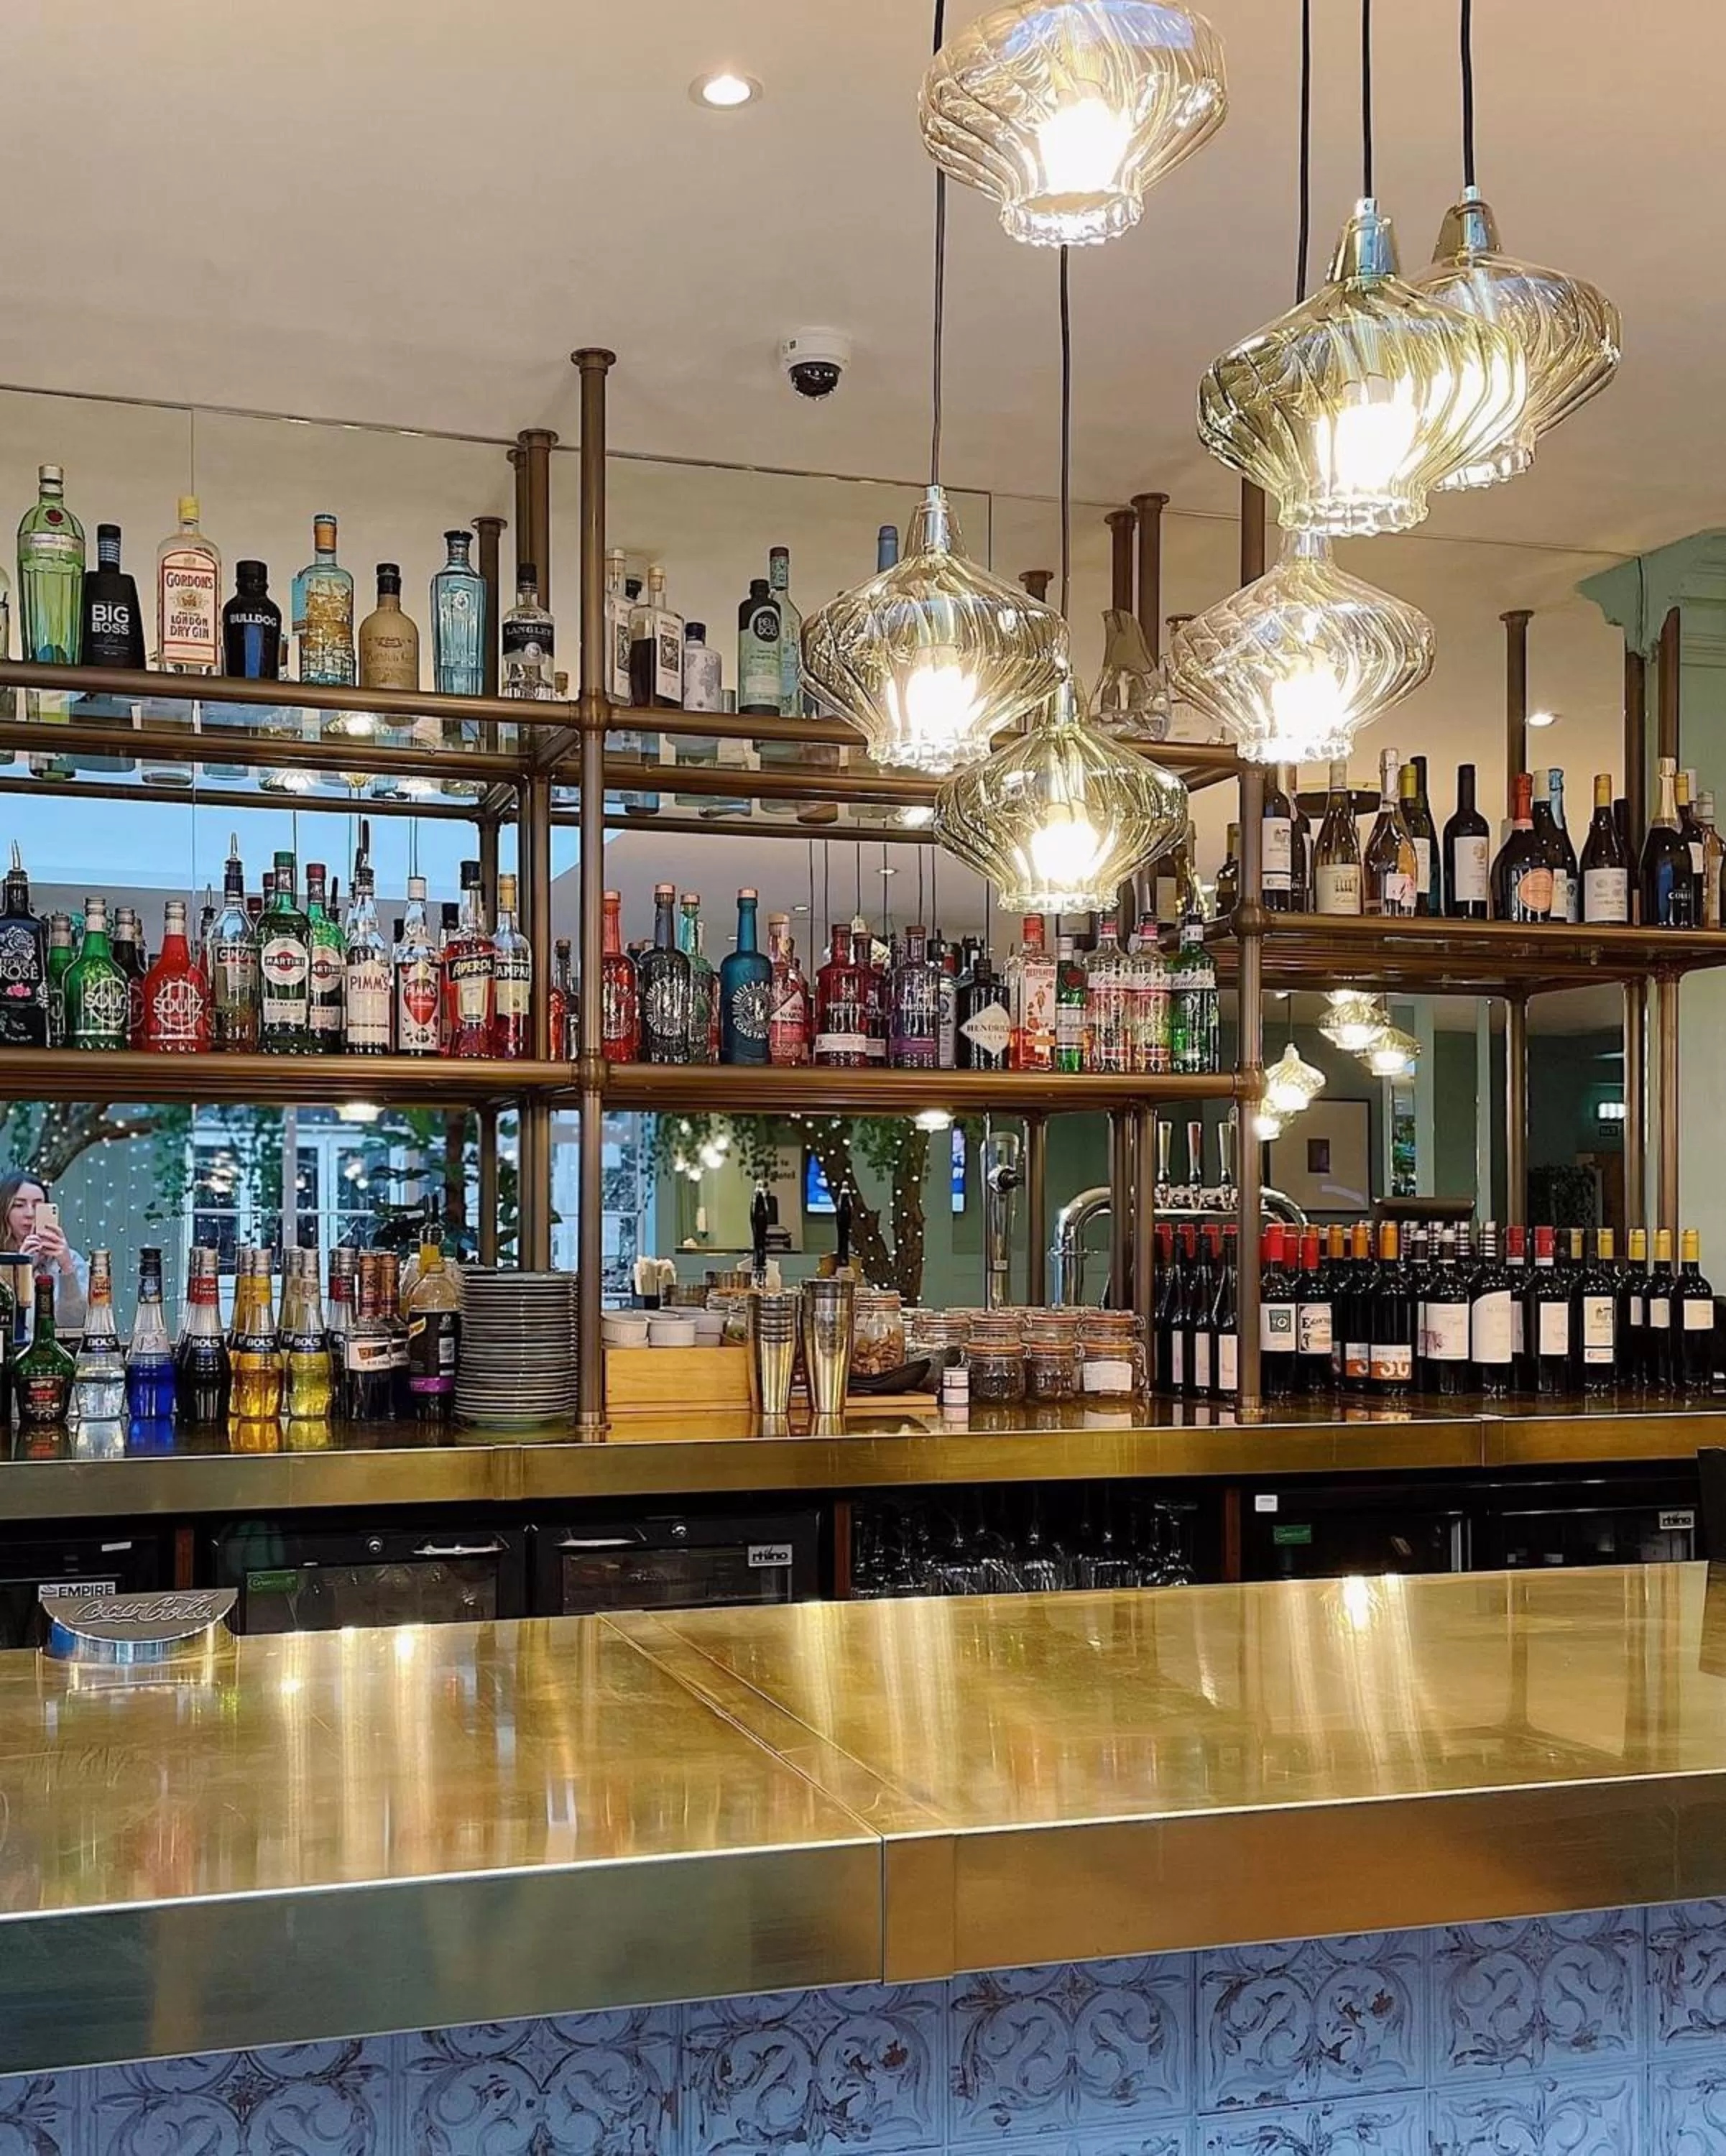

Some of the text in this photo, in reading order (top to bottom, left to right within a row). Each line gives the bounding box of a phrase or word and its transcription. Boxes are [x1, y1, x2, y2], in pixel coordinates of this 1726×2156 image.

[166, 571, 213, 589] GORDON'S
[91, 604, 129, 623] BIG
[170, 614, 208, 627] LONDON
[230, 613, 277, 627] BULLDOG
[91, 621, 129, 635] BOSS
[170, 625, 209, 638] DRY GIN
[266, 956, 305, 967] MARTINI
[452, 958, 492, 978] APEROL
[350, 973, 389, 991] PIMM'S
[87, 1337, 115, 1347] BOLS
[192, 1338, 220, 1348] BOLS
[246, 1336, 274, 1348] BOLS
[294, 1335, 321, 1347] BOLS
[752, 1546, 788, 1562] rhino
[58, 1583, 114, 1598] EMPIRE
